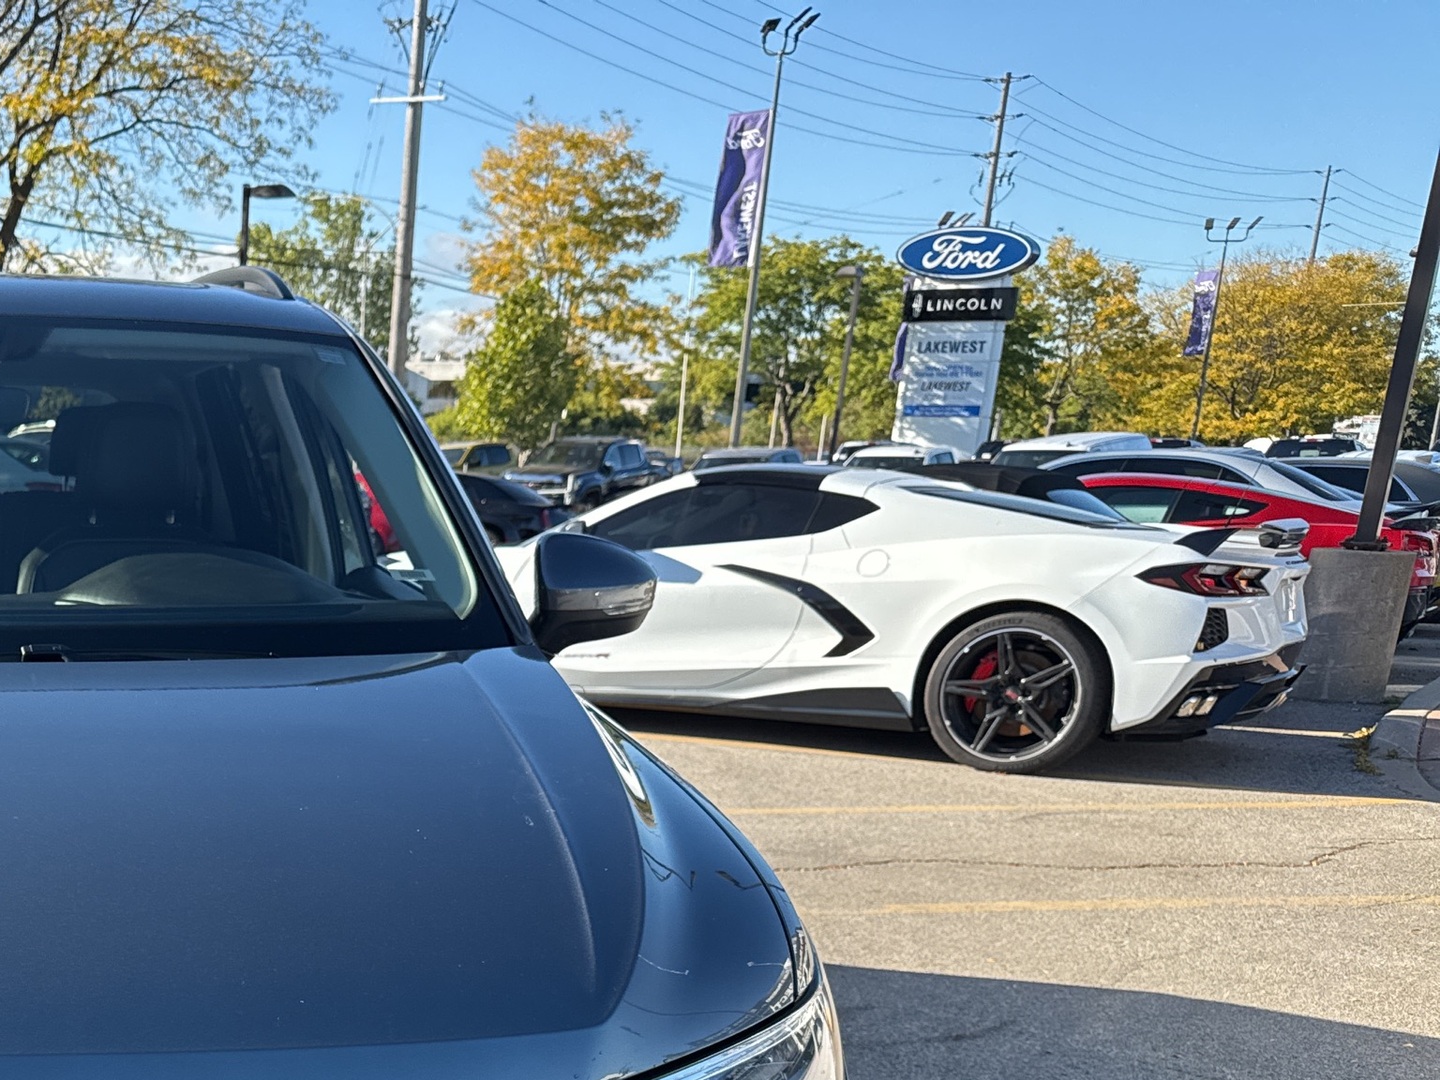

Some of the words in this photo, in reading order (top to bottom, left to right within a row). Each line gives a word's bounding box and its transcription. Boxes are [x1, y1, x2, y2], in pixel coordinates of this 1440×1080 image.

[922, 235, 1005, 269] Ford
[926, 298, 1002, 311] LINCOLN
[916, 340, 987, 354] LAKEWEST
